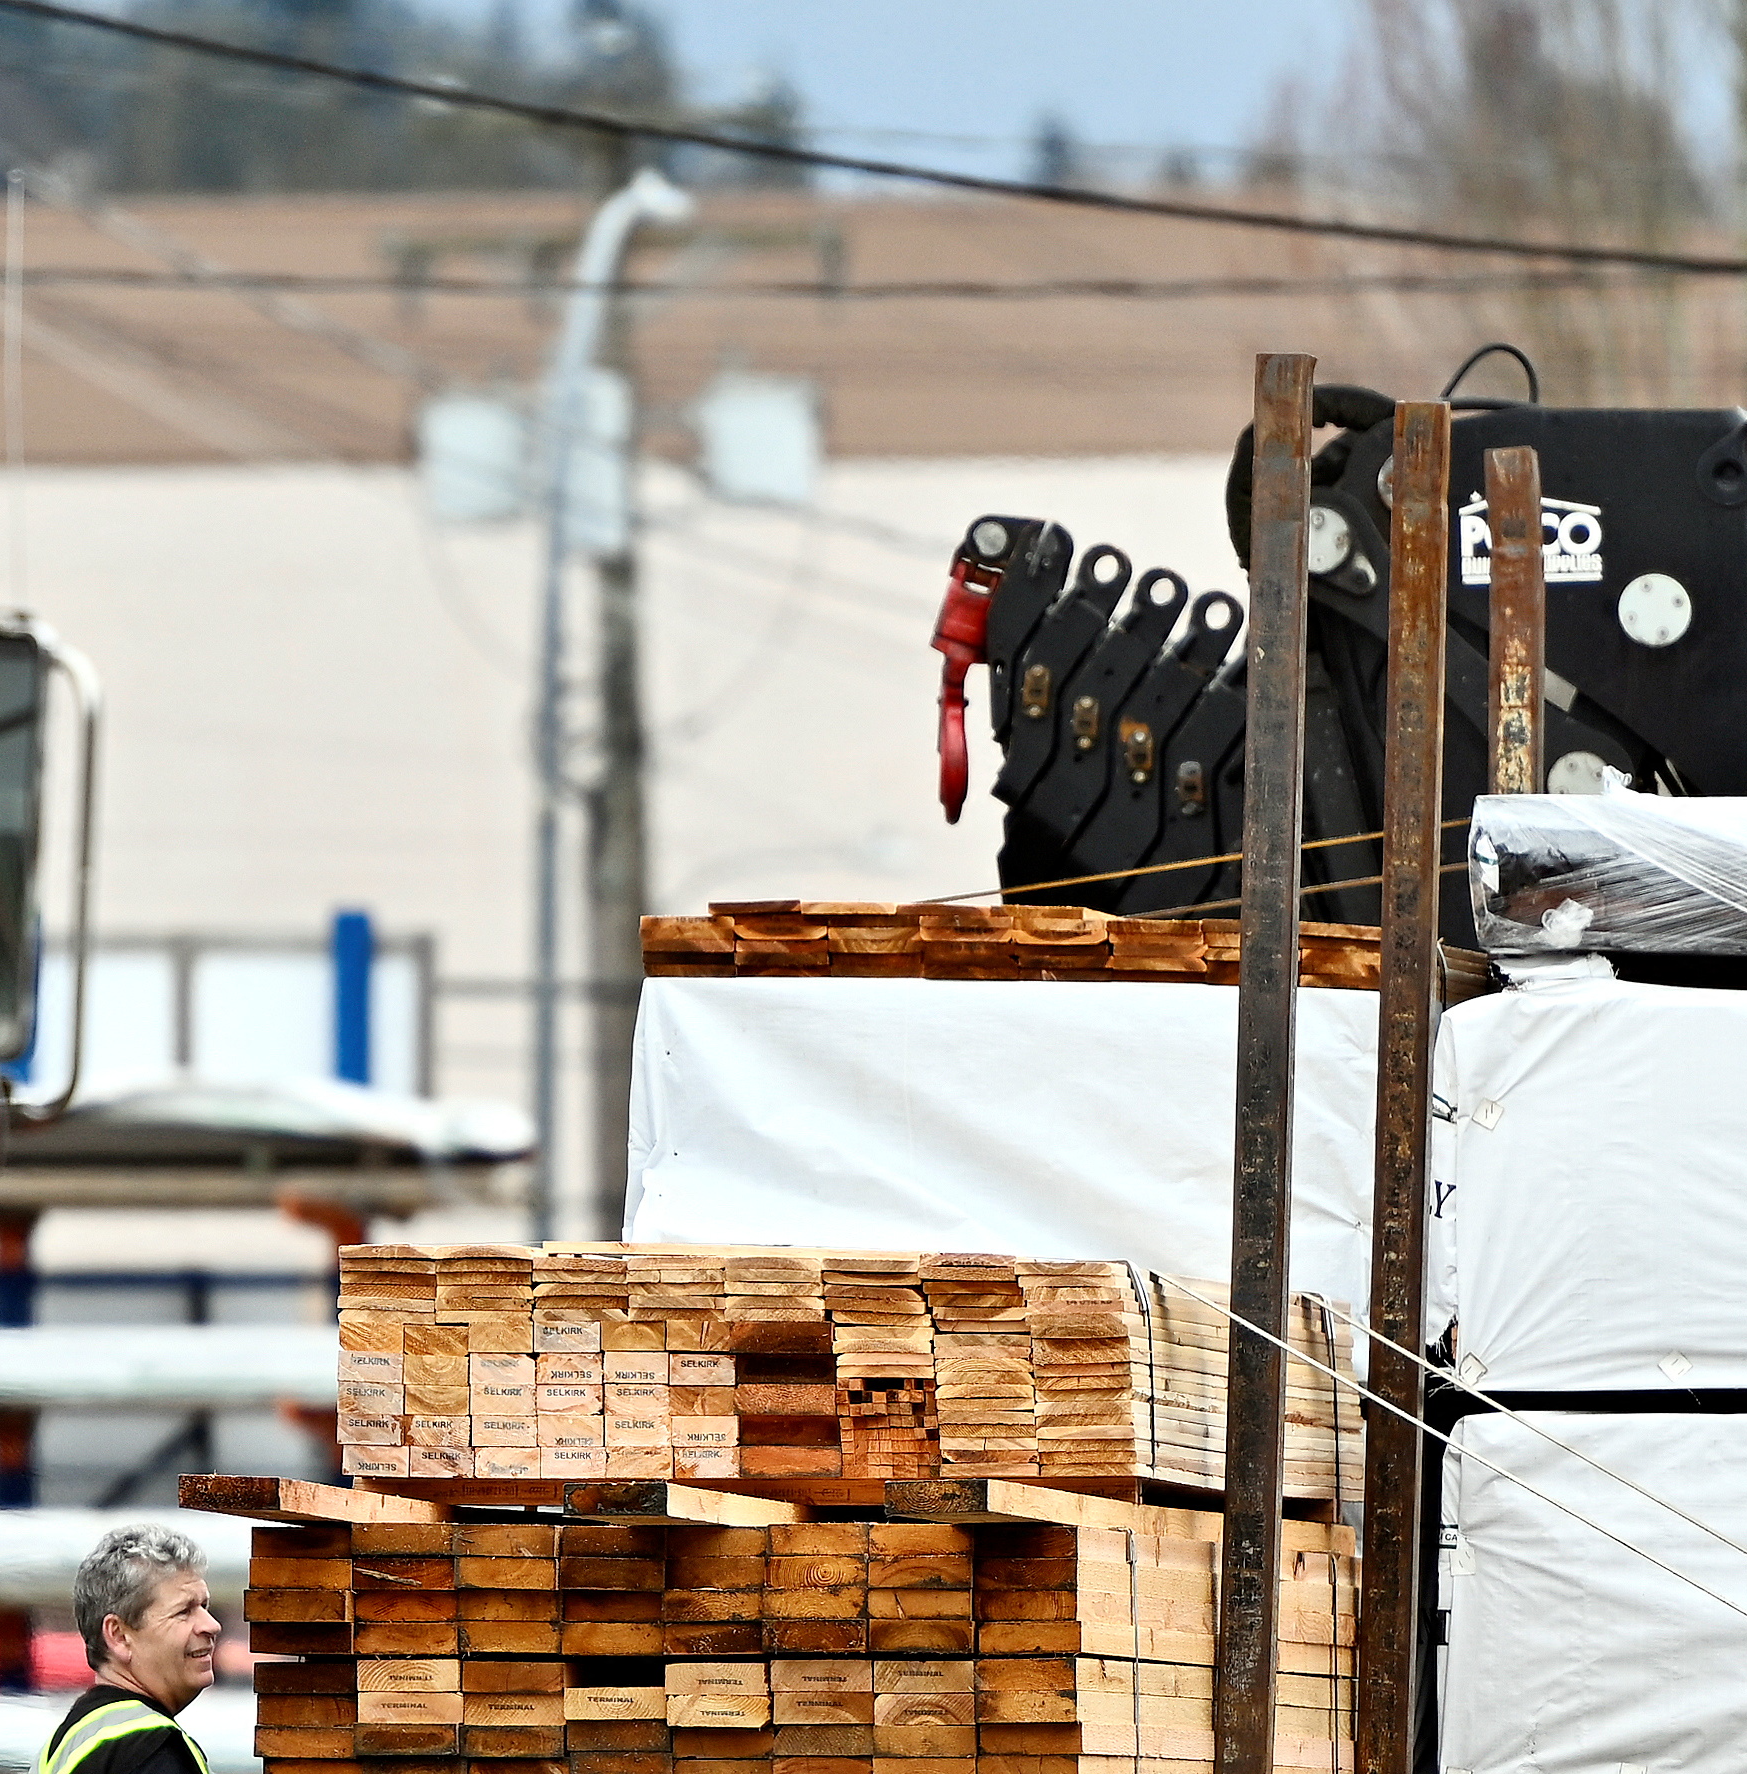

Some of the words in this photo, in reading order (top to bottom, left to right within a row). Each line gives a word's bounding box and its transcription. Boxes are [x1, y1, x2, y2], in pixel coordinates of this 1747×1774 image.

[680, 1360, 720, 1368] SELKIRK
[550, 1370, 592, 1379] SELKIRK
[615, 1371, 655, 1380] SELKIRK
[346, 1387, 386, 1397] SELKIRK
[483, 1387, 523, 1397] SELKIRK
[546, 1388, 586, 1397] SELKIRK
[616, 1388, 655, 1397] SELKIRK
[348, 1419, 389, 1429] SELKIRK
[415, 1420, 453, 1429] SELKIRK
[614, 1420, 655, 1429] SELKIRK
[687, 1433, 726, 1442] SELKIRK
[421, 1452, 461, 1460] SELKIRK
[554, 1451, 592, 1460] SELKIRK
[357, 1462, 397, 1471] SELKIRK
[487, 1703, 535, 1711] TERMINAL
